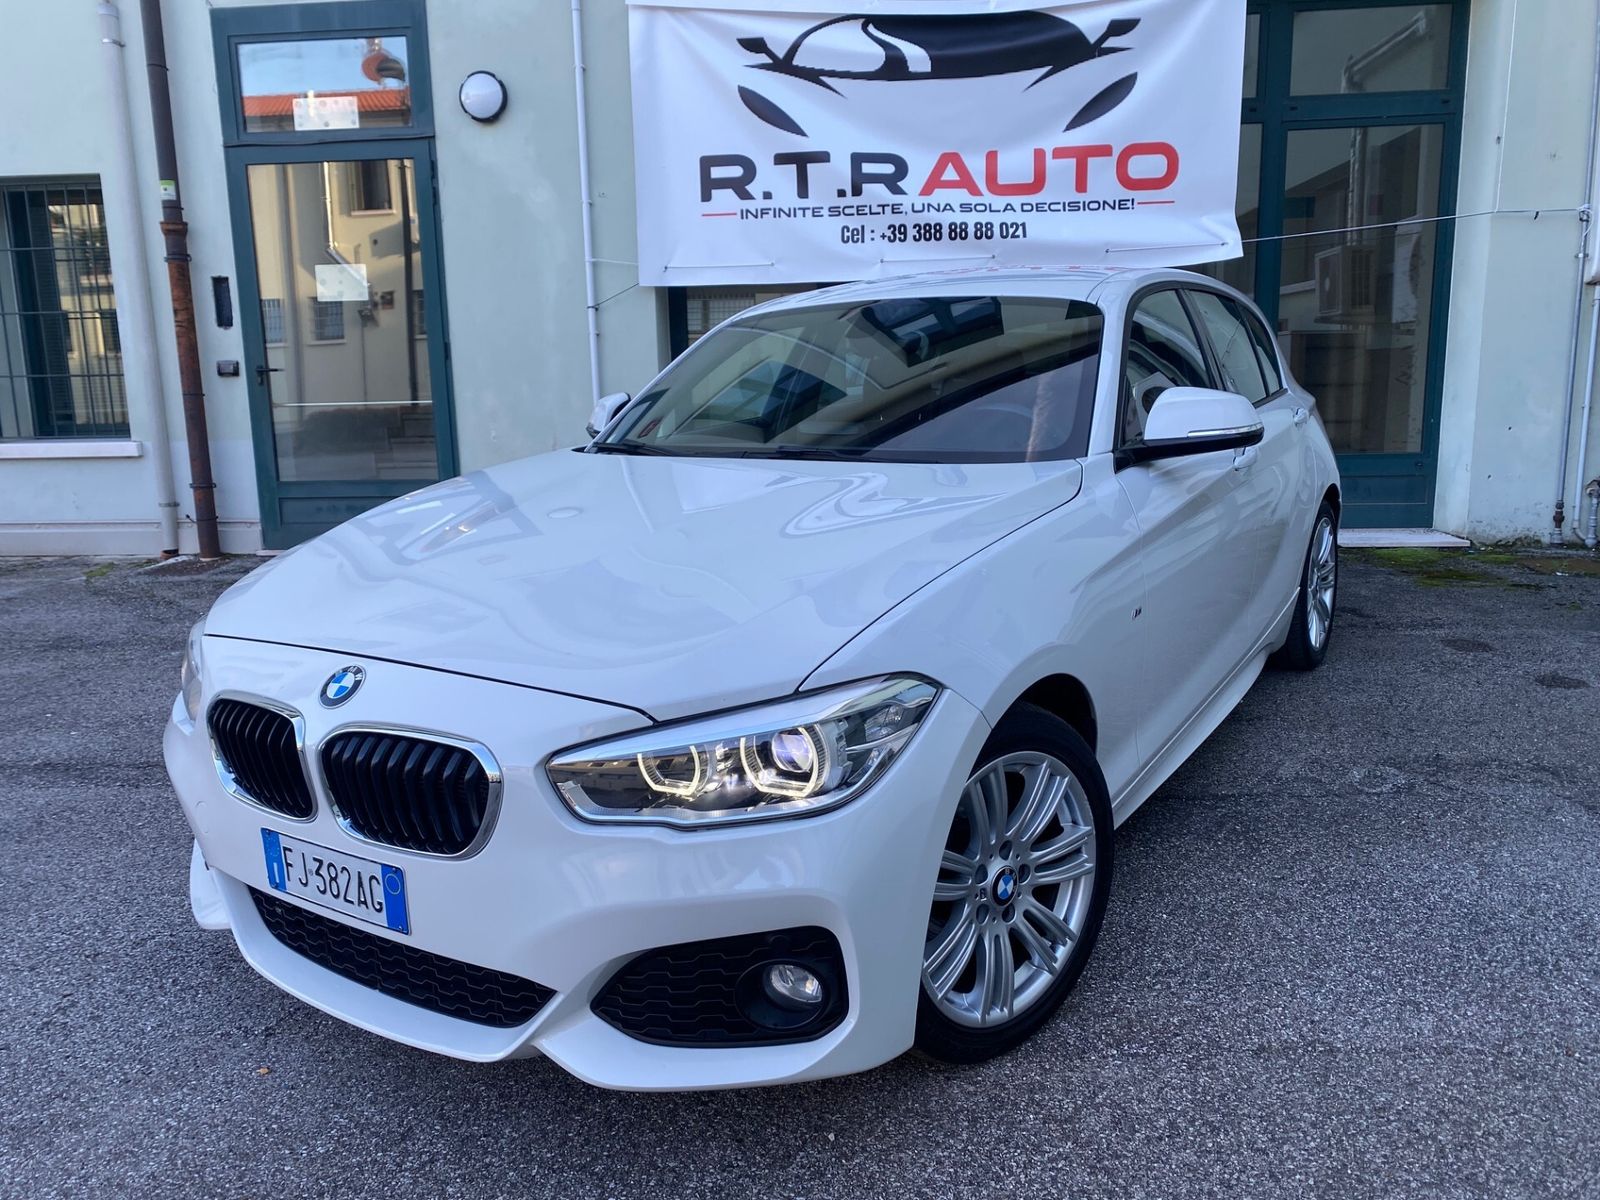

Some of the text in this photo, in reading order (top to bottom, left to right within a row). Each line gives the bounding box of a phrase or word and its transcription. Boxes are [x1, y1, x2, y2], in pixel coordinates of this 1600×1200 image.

[918, 141, 1179, 197] AUTO
[740, 198, 1135, 220] INFINITE SCELTE, UNA SOLA DECISIONE!
[840, 225, 865, 244] Cel
[880, 223, 907, 243] +39
[912, 222, 943, 242] 388
[948, 221, 968, 241] 88
[974, 221, 994, 240] 88
[1000, 221, 1027, 239] 021
